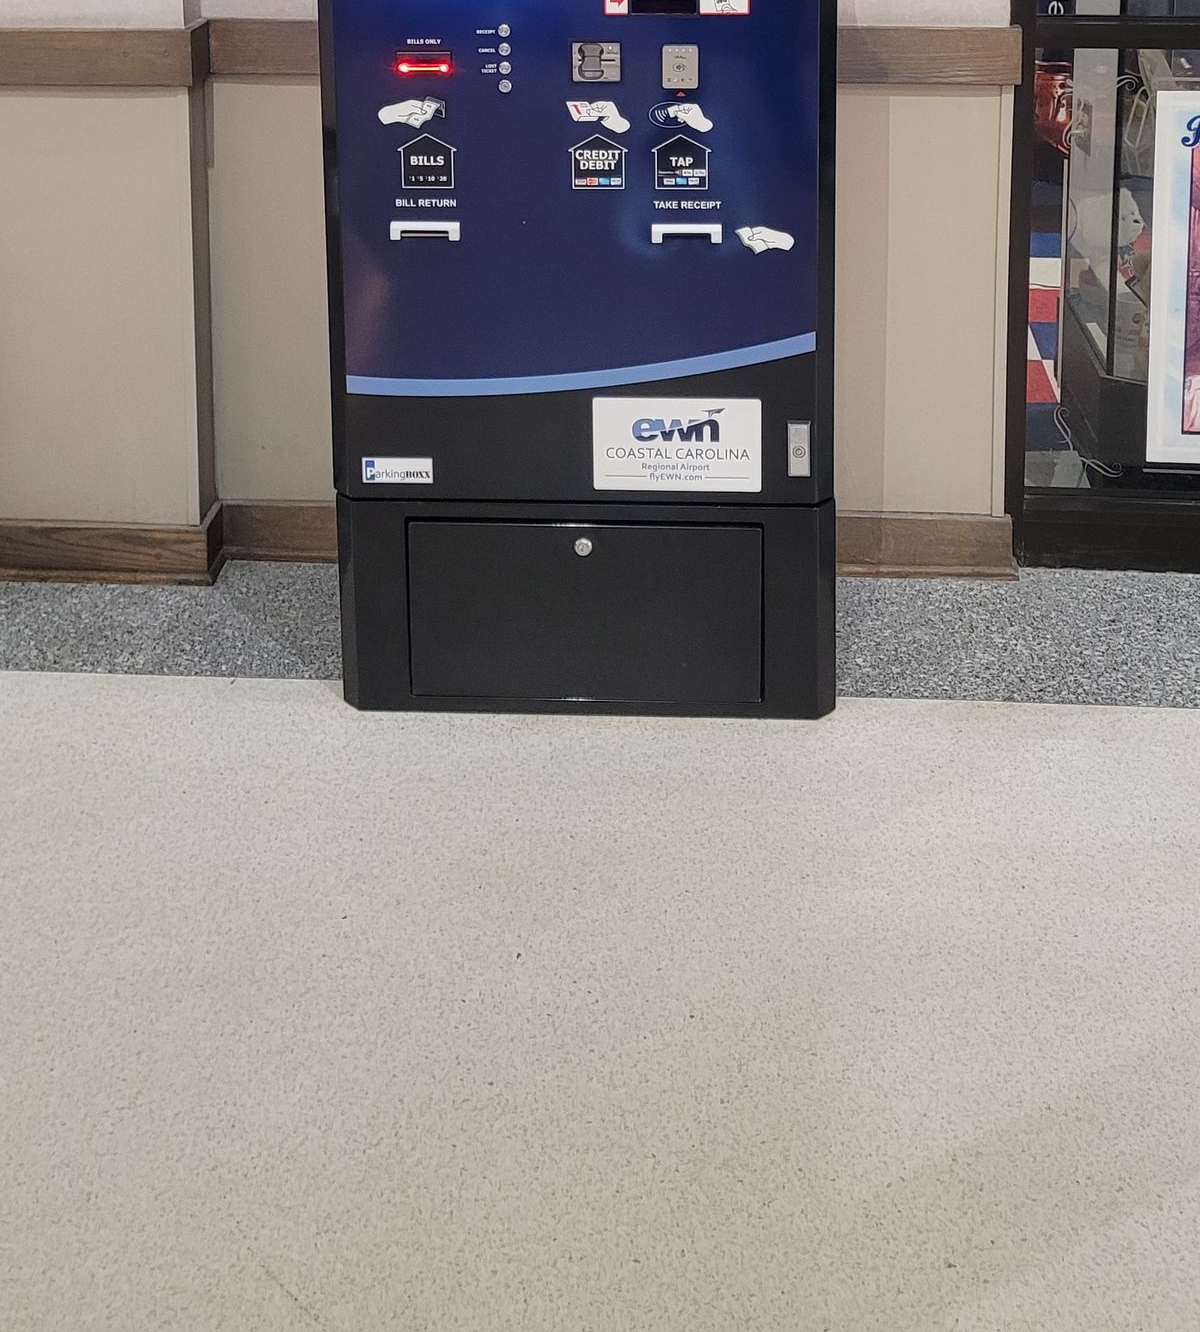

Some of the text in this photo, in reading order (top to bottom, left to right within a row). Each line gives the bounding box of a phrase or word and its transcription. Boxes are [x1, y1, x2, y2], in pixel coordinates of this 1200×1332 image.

[575, 150, 621, 160] CREDIT
[410, 155, 445, 166] BILLS
[580, 160, 617, 170] DEBIT
[669, 156, 694, 167] TAP
[395, 199, 457, 208] BILL RETURN
[653, 201, 722, 210] TAKE RECEIPT
[632, 417, 720, 443] ewn
[606, 447, 750, 461] COASTAL CAROLINA
[641, 463, 710, 473] Regional Airport
[649, 473, 703, 482] flyEWN.com
